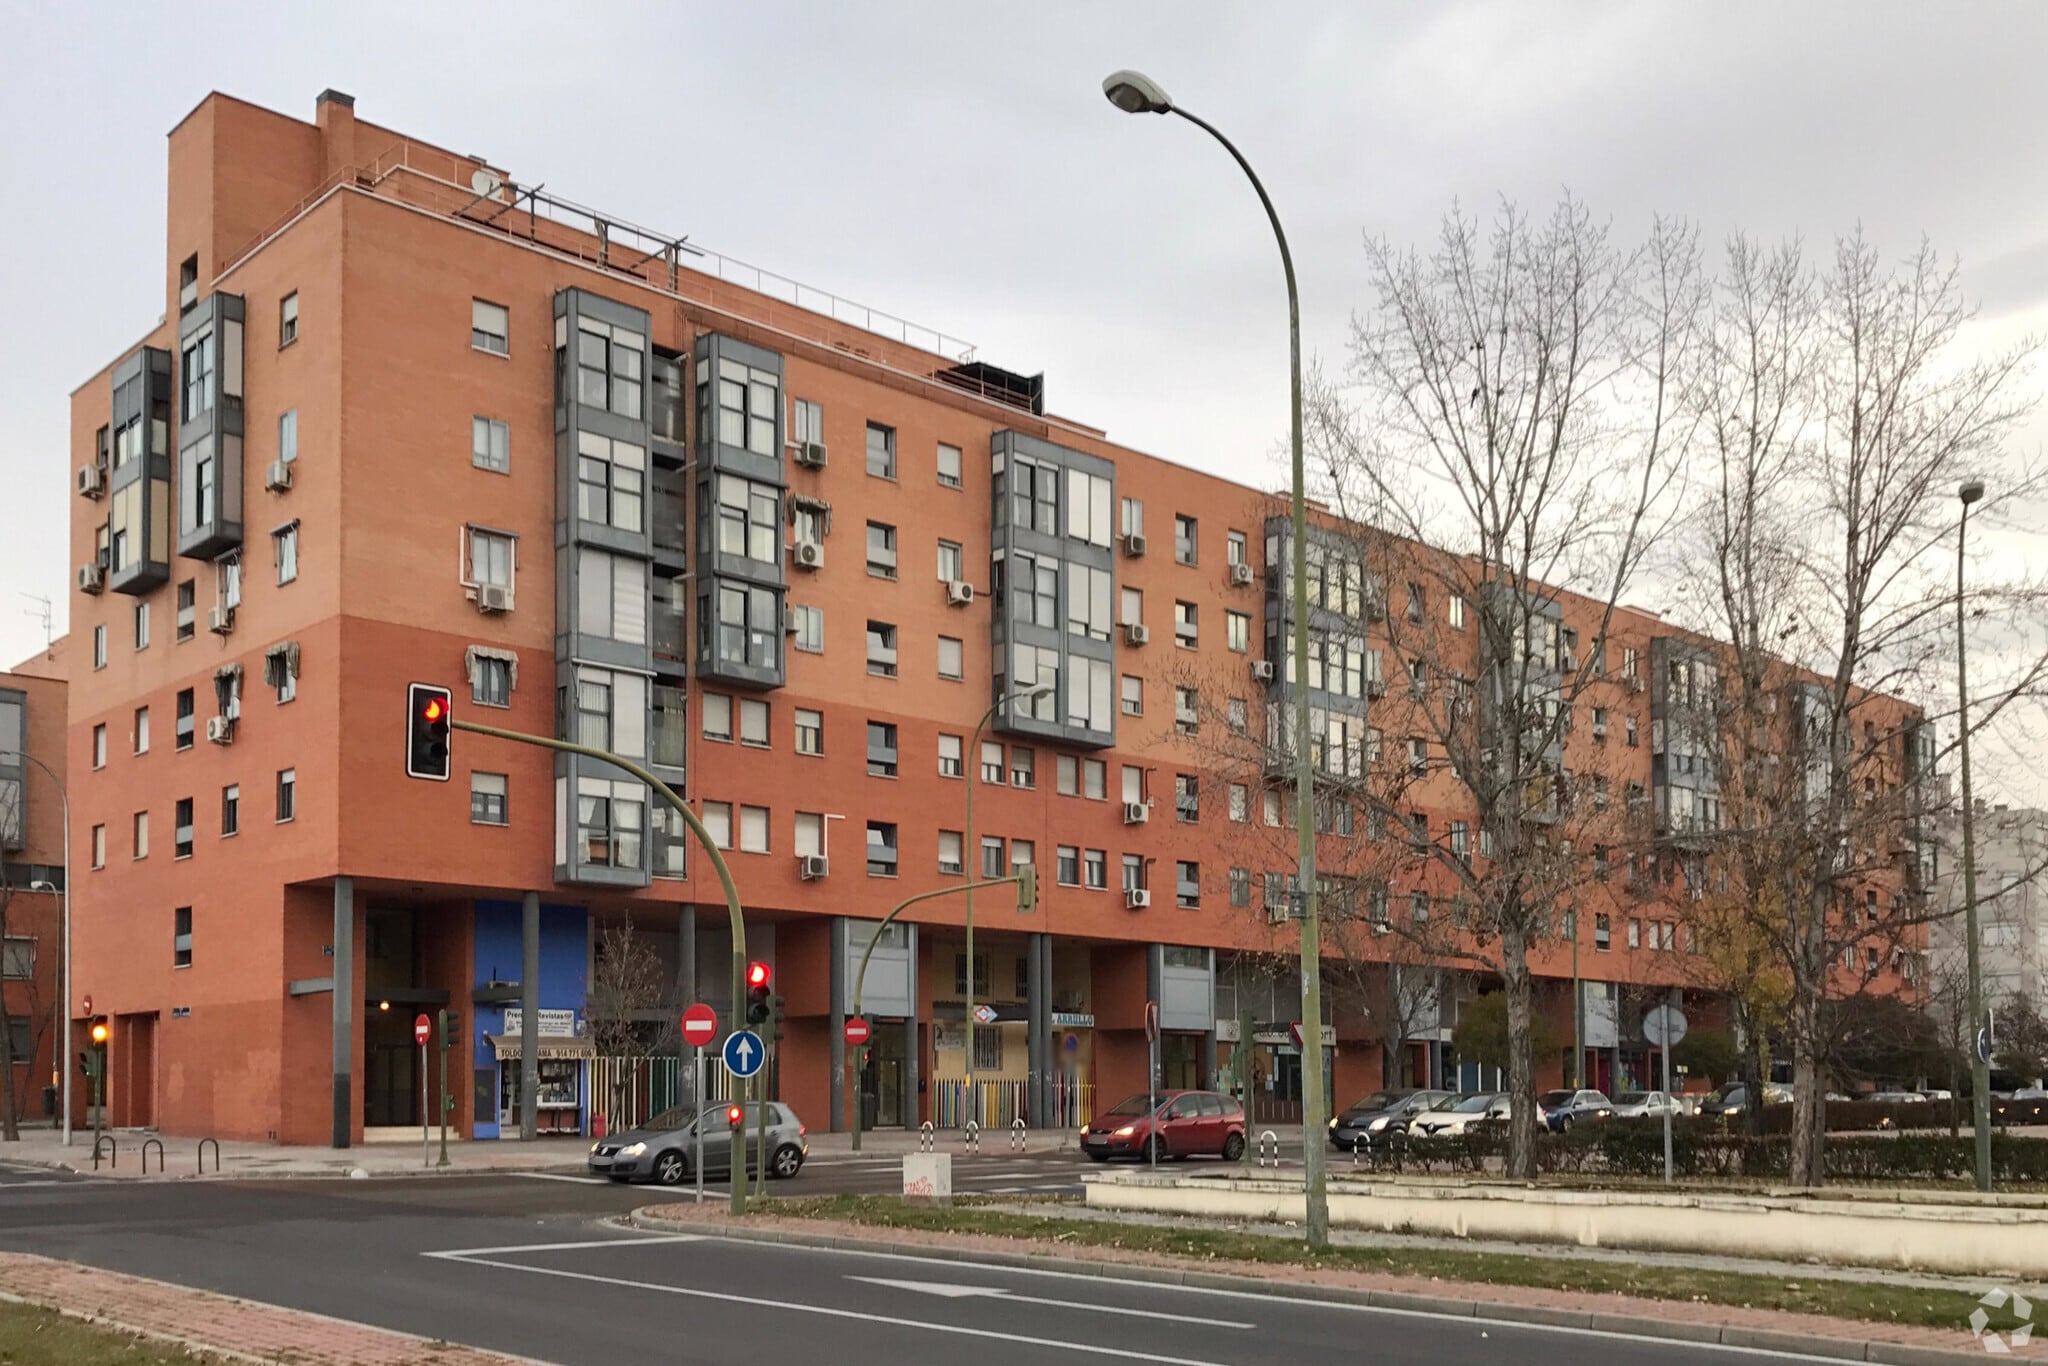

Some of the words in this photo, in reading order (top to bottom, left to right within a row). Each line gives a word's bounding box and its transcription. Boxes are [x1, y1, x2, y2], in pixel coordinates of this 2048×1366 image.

[507, 1010, 522, 1018] Pren
[1057, 1014, 1092, 1025] ARRULLO
[501, 1048, 522, 1057] TOLDO
